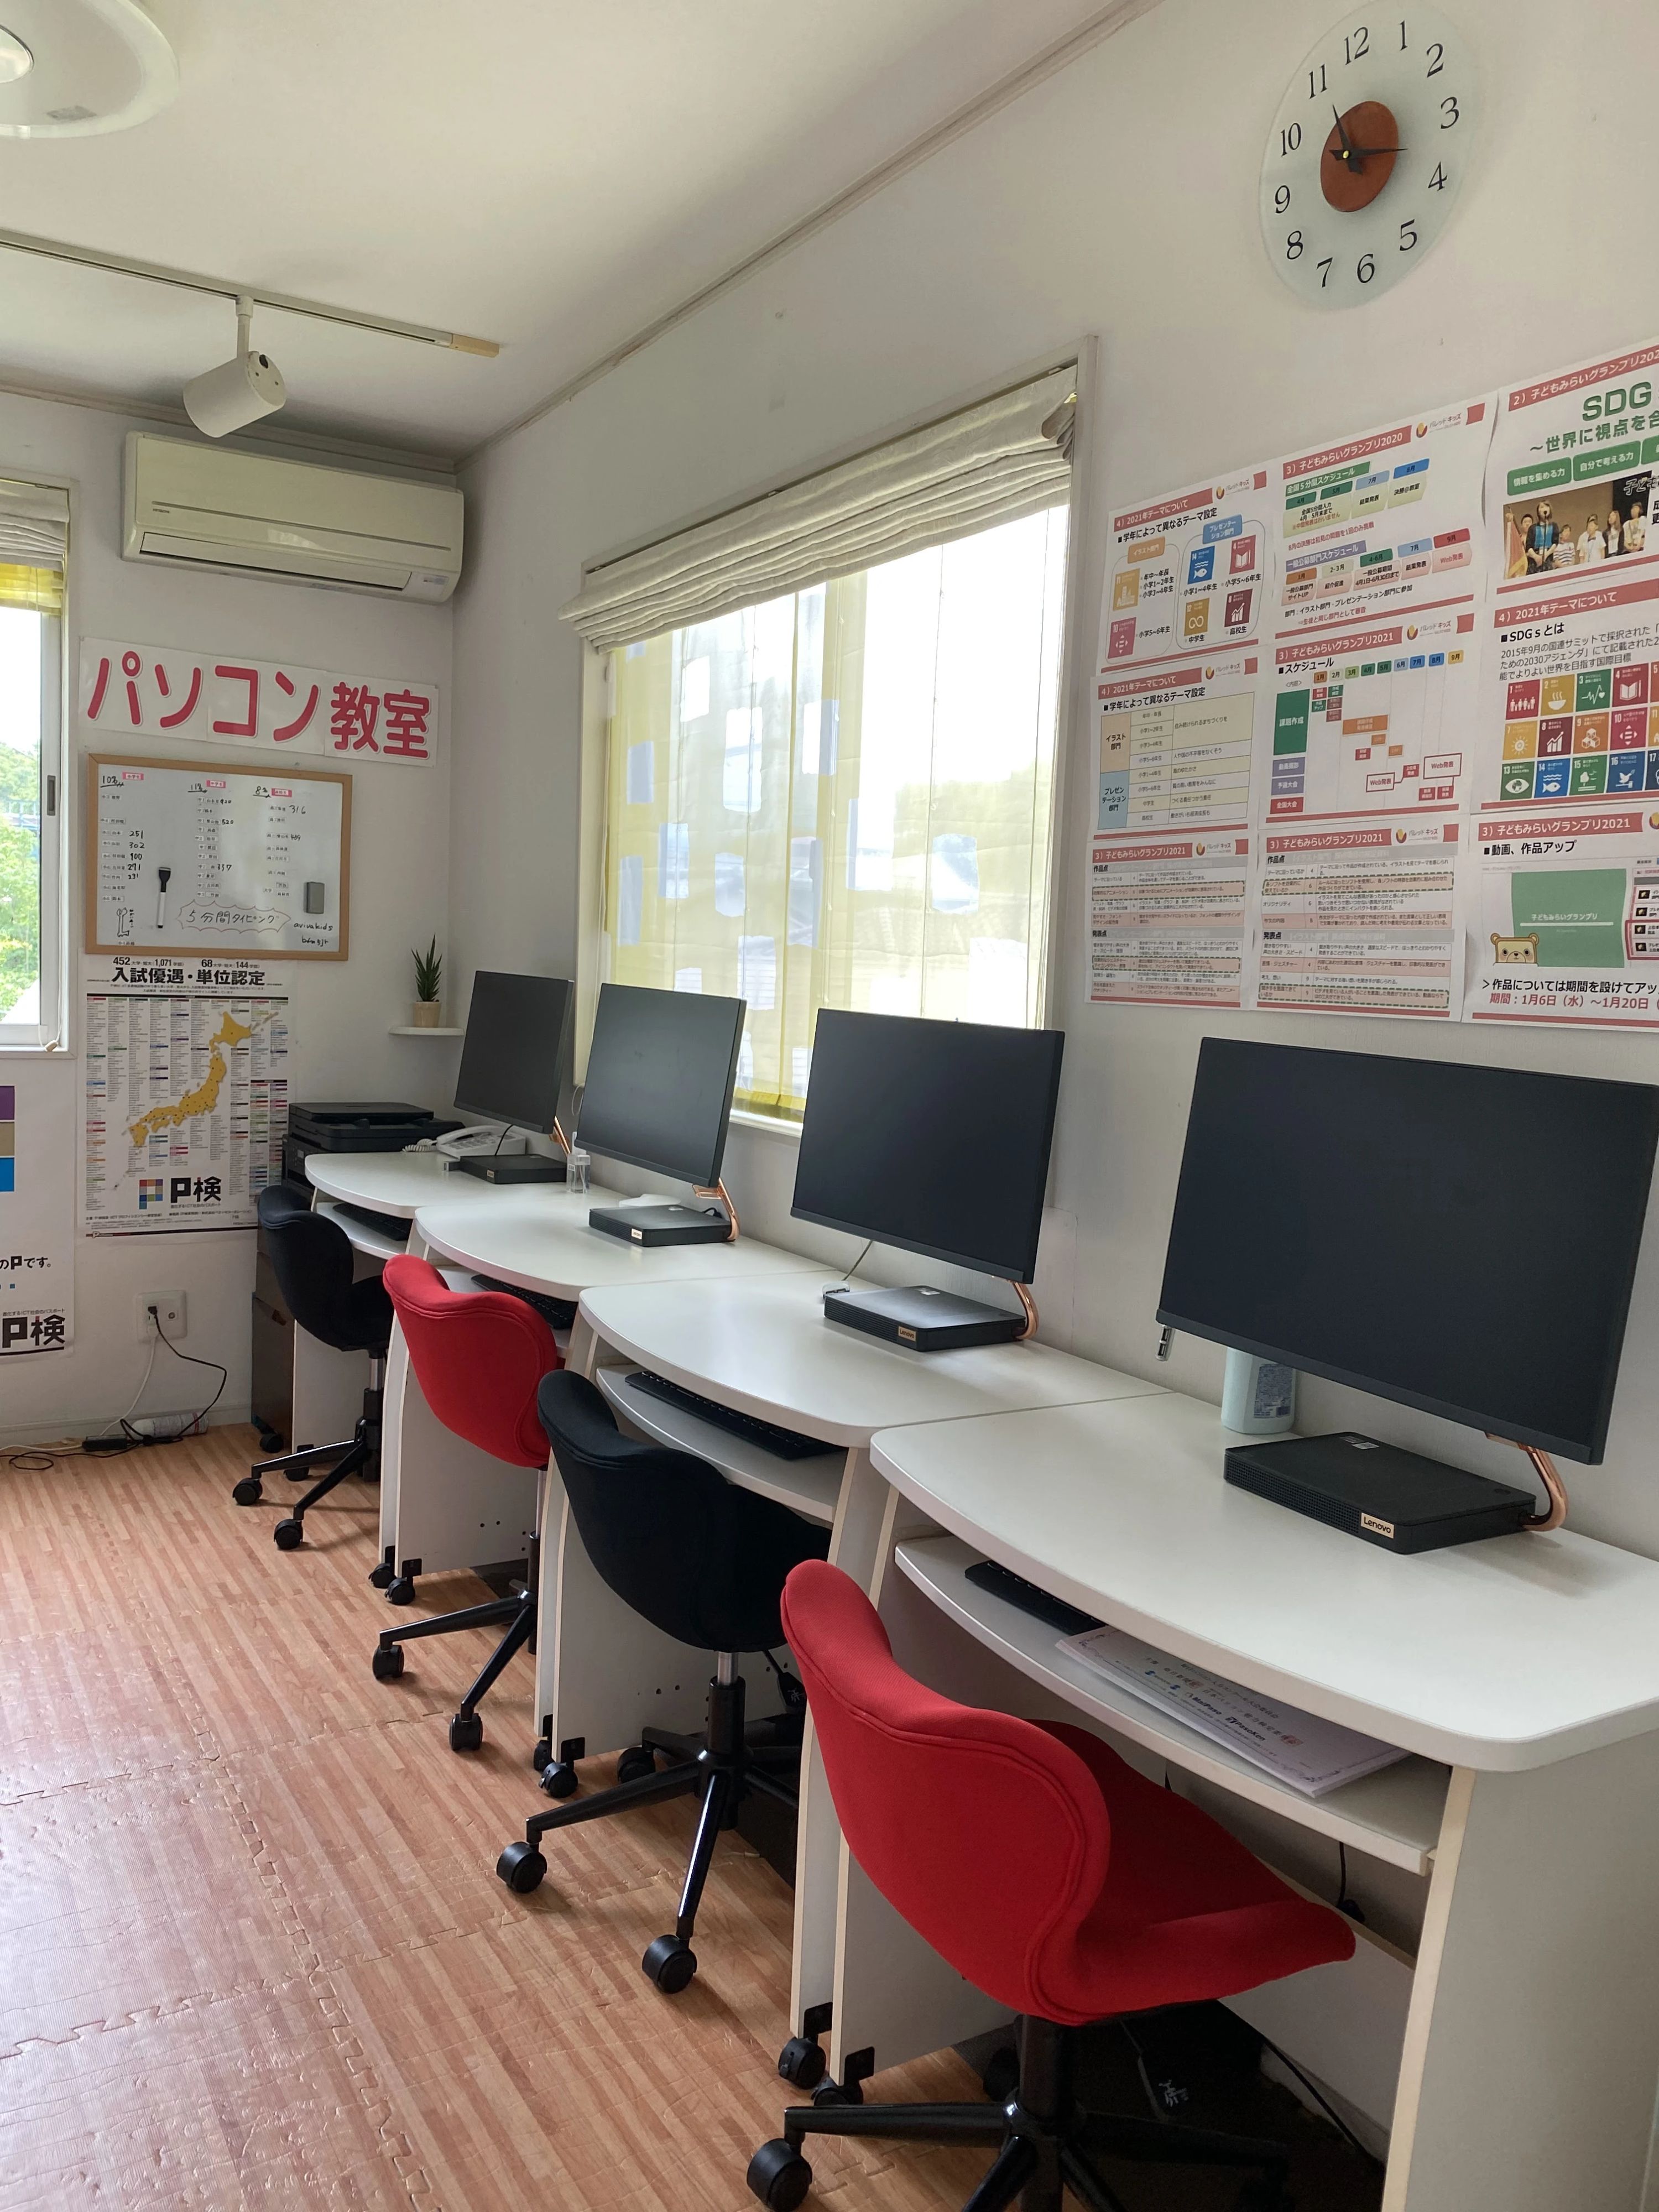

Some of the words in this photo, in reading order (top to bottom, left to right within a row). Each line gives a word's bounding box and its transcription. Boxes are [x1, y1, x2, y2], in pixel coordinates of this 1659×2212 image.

[1399, 20, 1408, 50] 1
[1344, 27, 1369, 65] 12
[1426, 43, 1444, 78] 2
[1308, 64, 1328, 99] 11
[1441, 96, 1459, 129] 3
[1281, 123, 1301, 156] 10
[1428, 161, 1447, 191] 4
[1275, 185, 1291, 213] 9
[1286, 230, 1303, 259] 8
[1400, 219, 1417, 251] 5
[1317, 258, 1333, 288] 7
[1357, 253, 1375, 283] 6
[1286, 432, 1402, 474] 3）子どもみらいグランプリ2020
[1580, 452, 1634, 471] 自分で考える力
[1514, 468, 1565, 486] 情報を集める力
[1117, 499, 1188, 528] 4）2021年テーマについて
[1124, 507, 1217, 542] 学年によって異なるテーマ設定
[1440, 552, 1464, 564] Web発表
[1288, 591, 1310, 601] サイトUP
[1499, 592, 1618, 622] 4）2021年テーマについて
[1229, 626, 1247, 635] 高校生
[1279, 633, 1394, 660] 3）子どもみらいグランプリ2021
[1284, 656, 1334, 674] スケジュール
[1500, 653, 1632, 681] 能でよりよい世界を目指す国際目標
[1616, 670, 1620, 679] 4
[1102, 676, 1176, 695] 4）2021年テーマについて
[1545, 680, 1549, 688] 2
[1579, 676, 1584, 684] 3
[87, 651, 430, 759] パソコン教室
[1109, 687, 1205, 711] 学年によって異なるテーマ設定
[1542, 722, 1546, 731] 8
[1577, 718, 1582, 727] 9
[1615, 714, 1622, 722] 10
[1105, 733, 1126, 742] イラスト
[1431, 761, 1454, 769] Web発表
[1611, 757, 1619, 765] 16
[1650, 753, 1657, 761] 17
[1102, 795, 1126, 804] テーション
[1482, 818, 1630, 837] 3）子どもみらいグランプリ2021
[1270, 834, 1383, 849] 3）子どもみらいグランプリ2021
[1491, 839, 1577, 856] 動画、作品アップ
[1095, 847, 1185, 860] 3）子どもみらいグランプリ2021
[1267, 855, 1285, 864] 作品点
[111, 967, 265, 985] 入試優遇・単位認定
[170, 1176, 222, 1203] P検
[2, 1314, 65, 1348] P検
[899, 1329, 915, 1339] Lenovo
[1364, 1517, 1391, 1533] Lenovo
[1235, 1721, 1266, 1741] PasoKen
